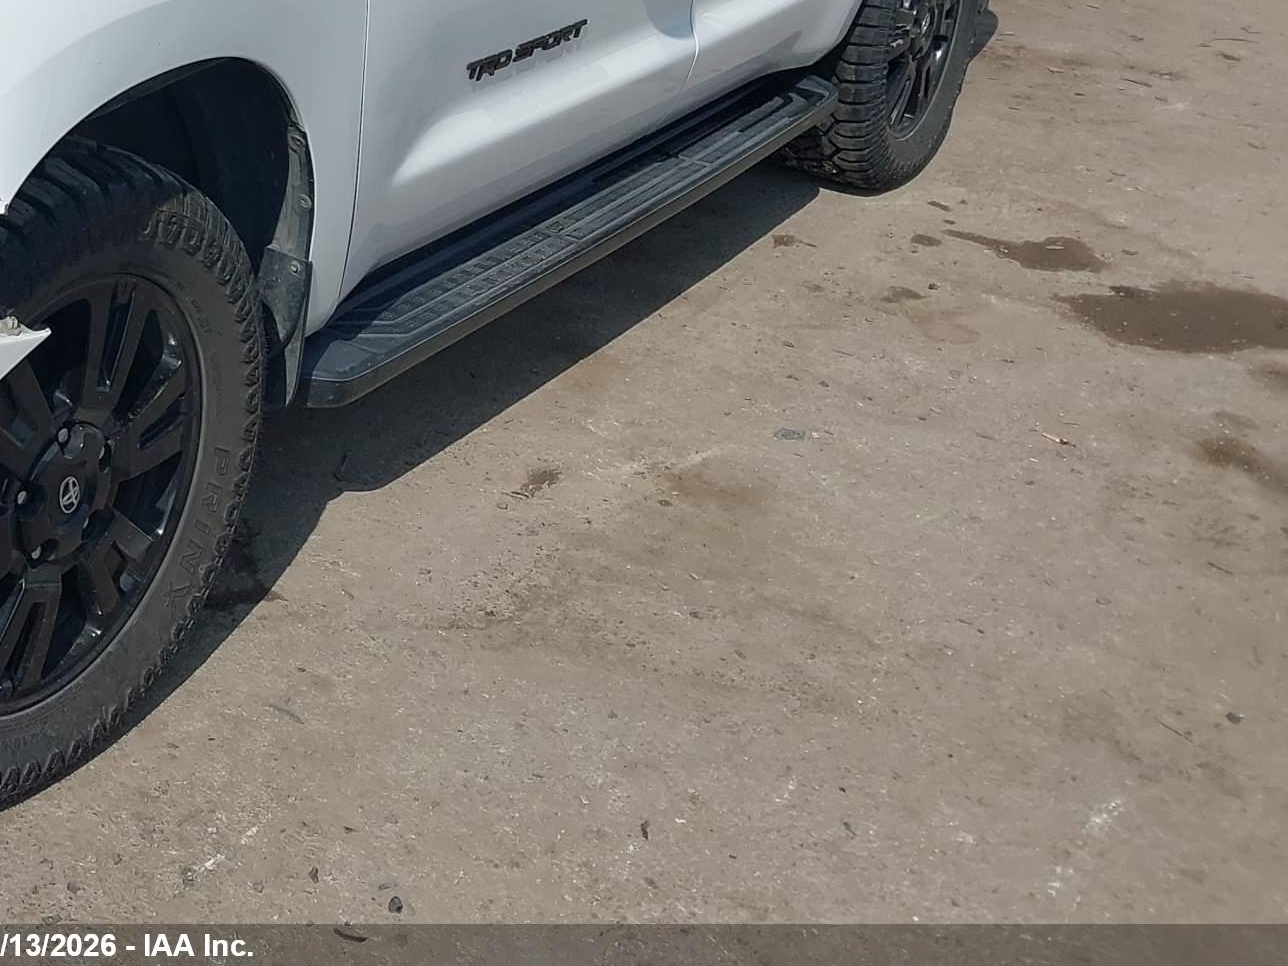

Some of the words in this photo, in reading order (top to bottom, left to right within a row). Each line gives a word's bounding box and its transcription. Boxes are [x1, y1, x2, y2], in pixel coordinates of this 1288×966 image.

[466, 48, 513, 82] TRD
[512, 18, 588, 63] SPORT
[161, 445, 232, 619] PRINX
